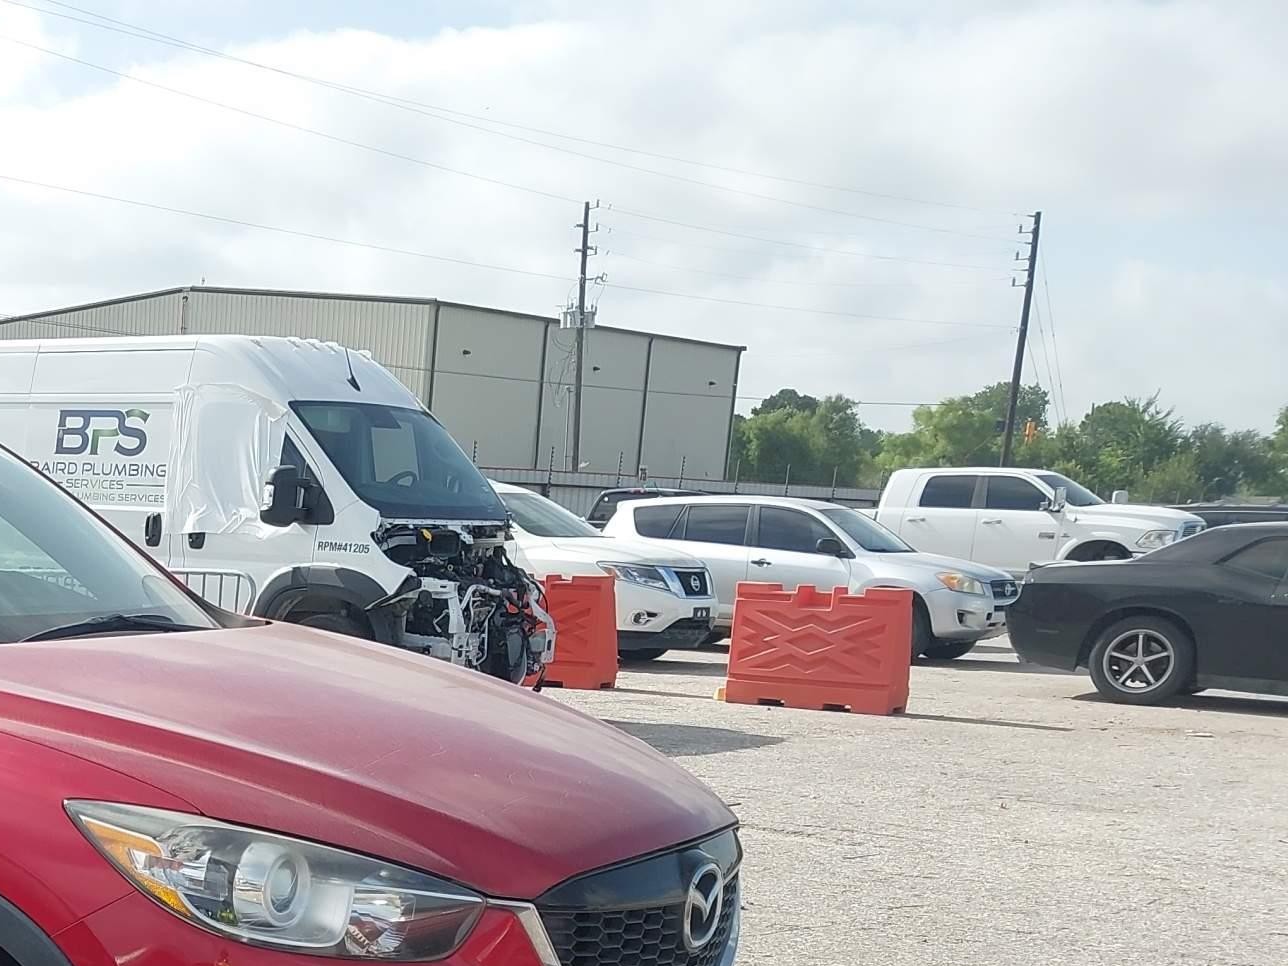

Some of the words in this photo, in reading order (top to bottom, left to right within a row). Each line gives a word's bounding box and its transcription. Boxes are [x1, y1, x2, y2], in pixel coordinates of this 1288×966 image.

[54, 408, 151, 457] BPS
[81, 462, 167, 478] PLUMBING
[65, 478, 124, 490] SERVICES
[73, 491, 116, 502] UMBING
[117, 493, 165, 503] SERVICES
[317, 541, 371, 554] RPM#41205
